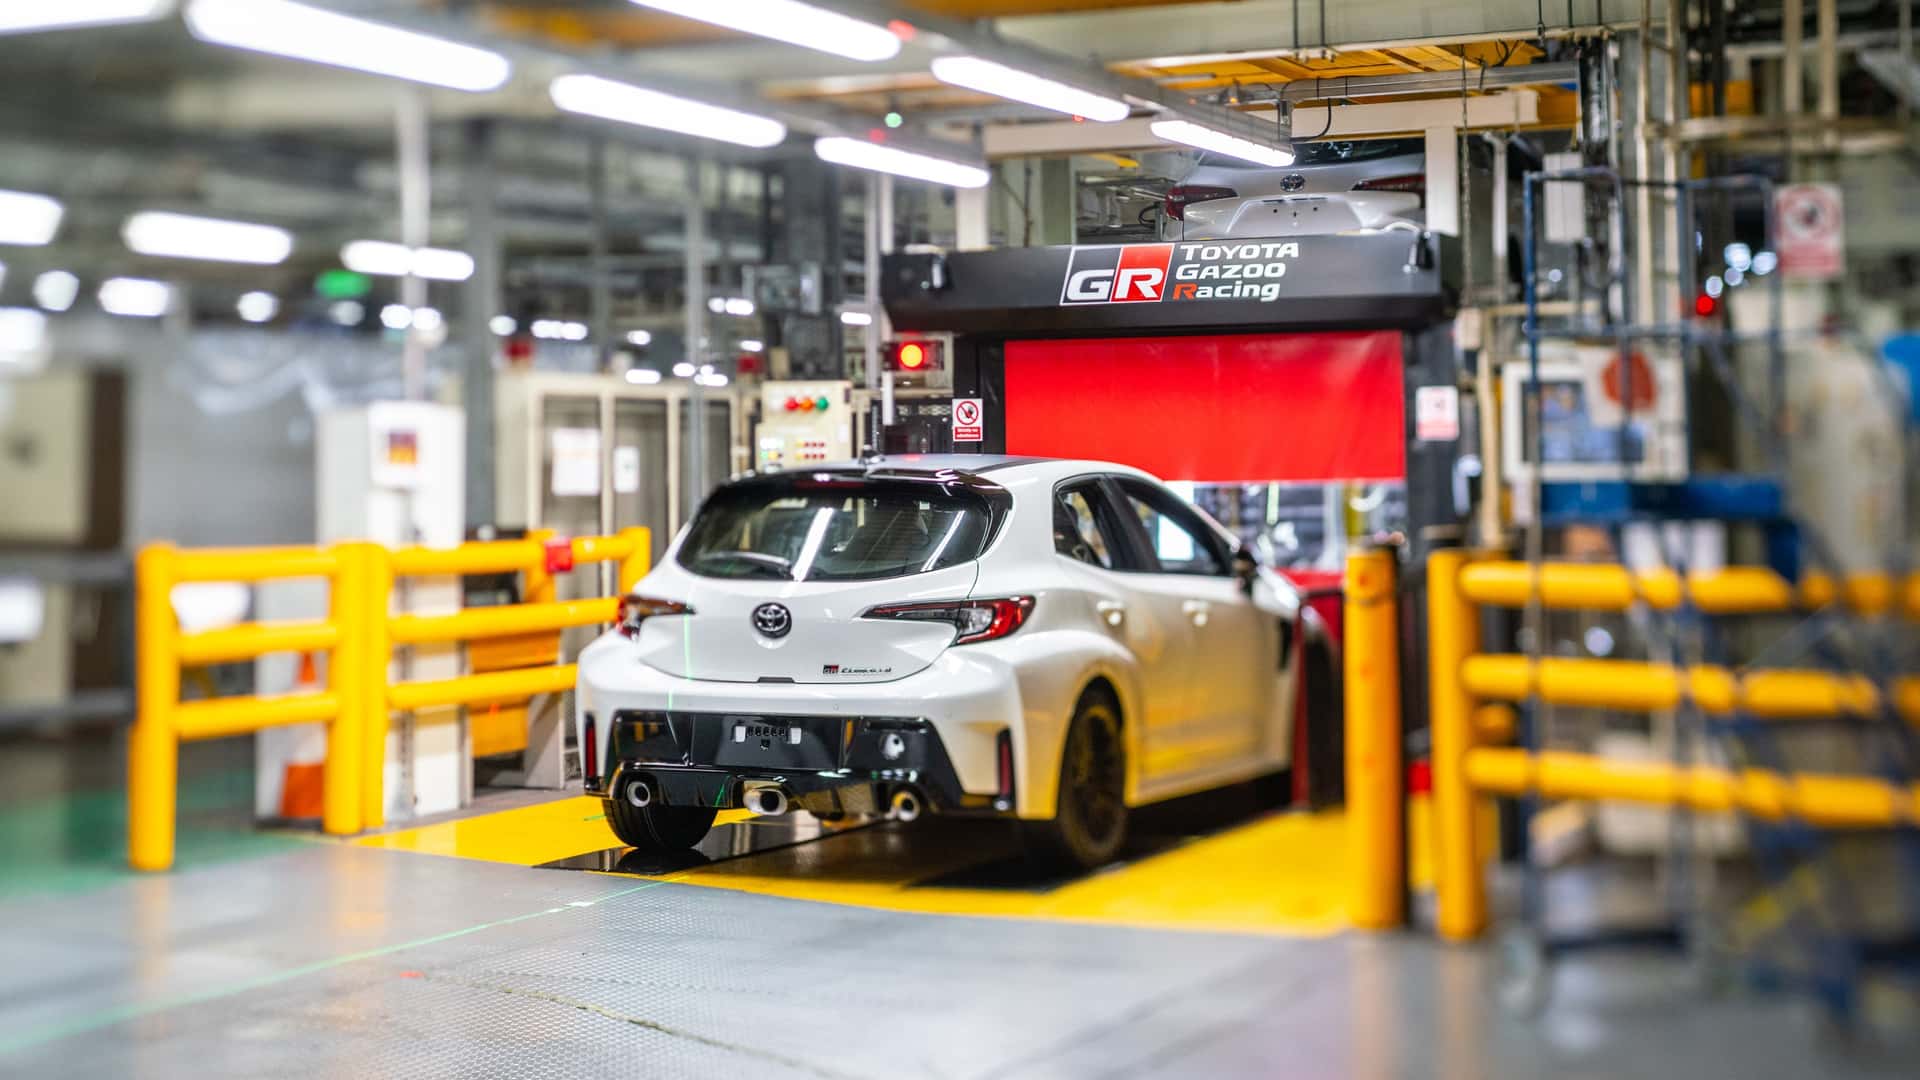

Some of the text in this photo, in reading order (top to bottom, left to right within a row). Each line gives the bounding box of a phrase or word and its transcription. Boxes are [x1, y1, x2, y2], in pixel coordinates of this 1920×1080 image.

[1180, 243, 1299, 261] TOYOTA
[1176, 263, 1286, 280] GAZOO
[1066, 268, 1164, 301] GR
[1173, 281, 1281, 302] Racing
